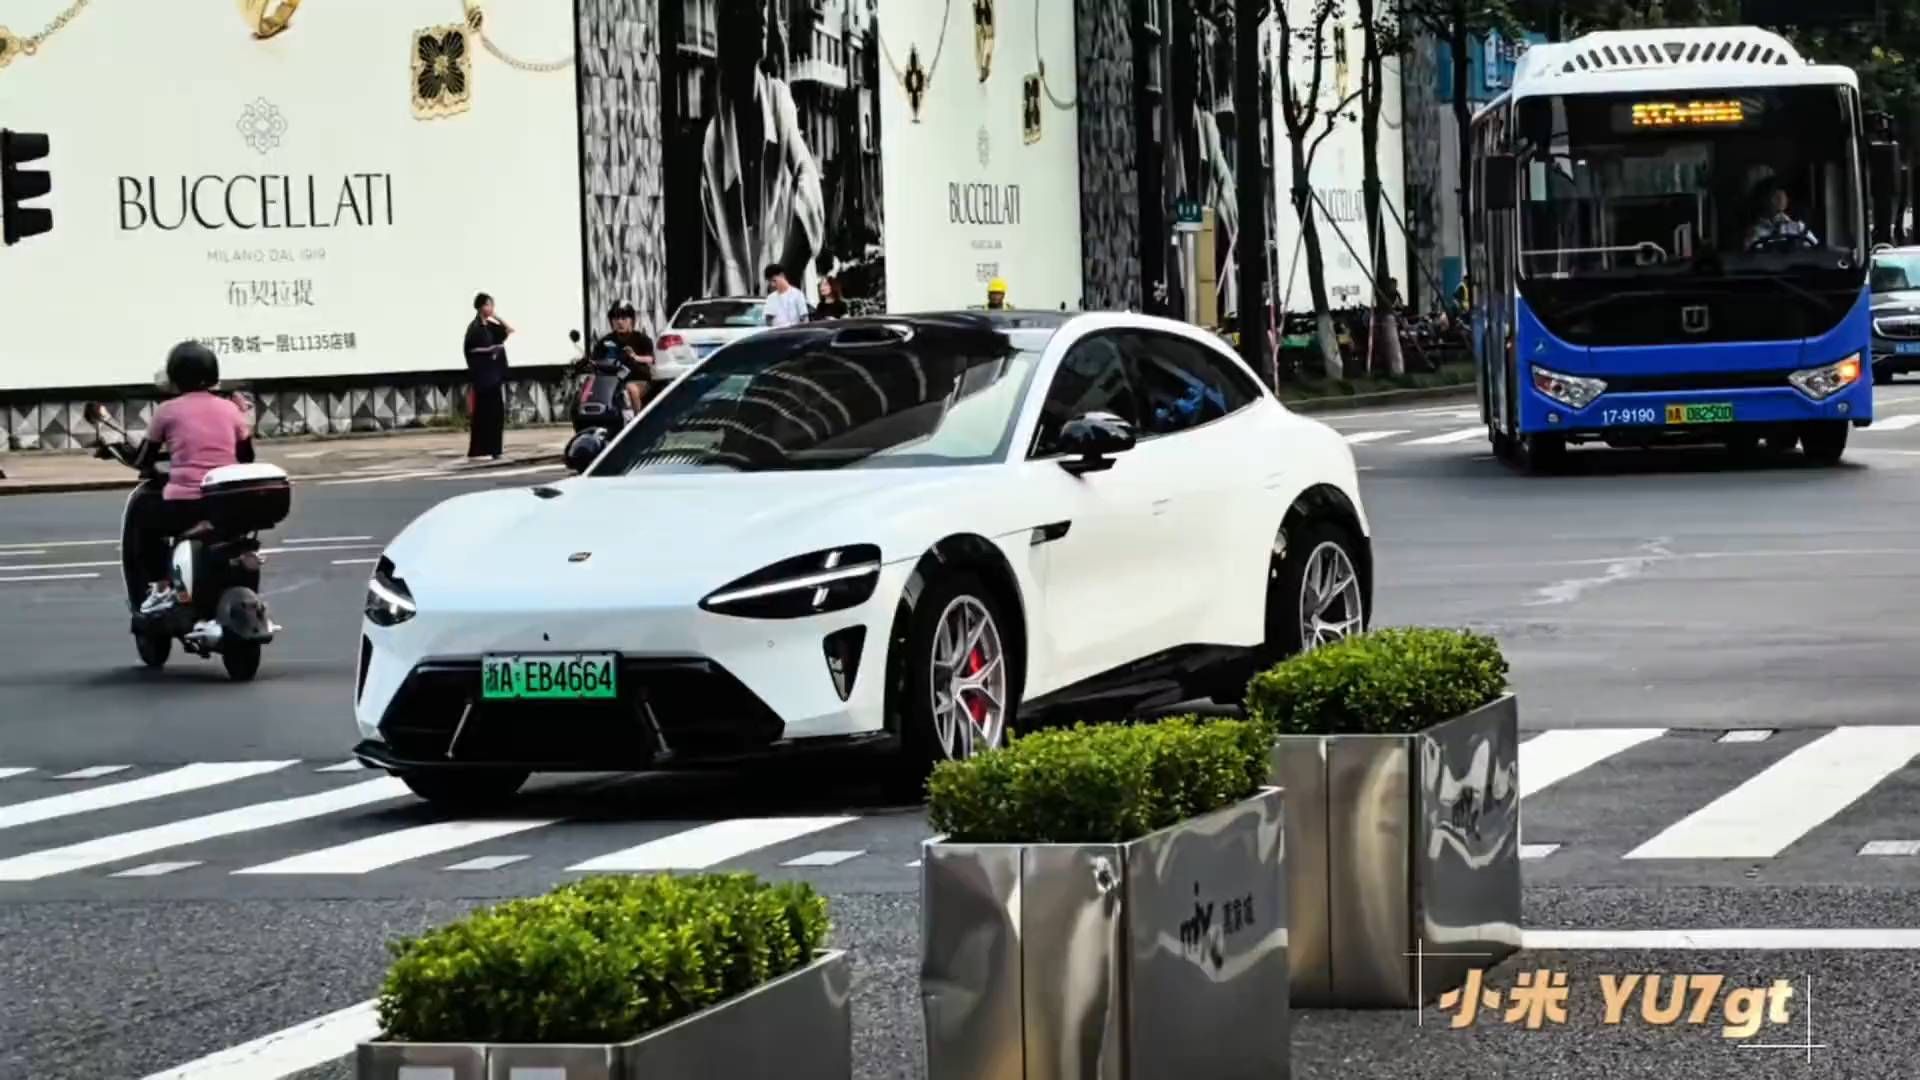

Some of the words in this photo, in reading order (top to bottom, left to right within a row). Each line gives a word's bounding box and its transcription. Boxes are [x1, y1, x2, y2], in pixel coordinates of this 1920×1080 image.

[117, 173, 393, 230] BUCCELLATI
[948, 181, 1021, 225] BUCCELLATI
[207, 249, 265, 263] MILANO
[268, 249, 296, 262] DAL
[1602, 408, 1656, 424] 17-9190
[524, 660, 613, 692] EB4664
